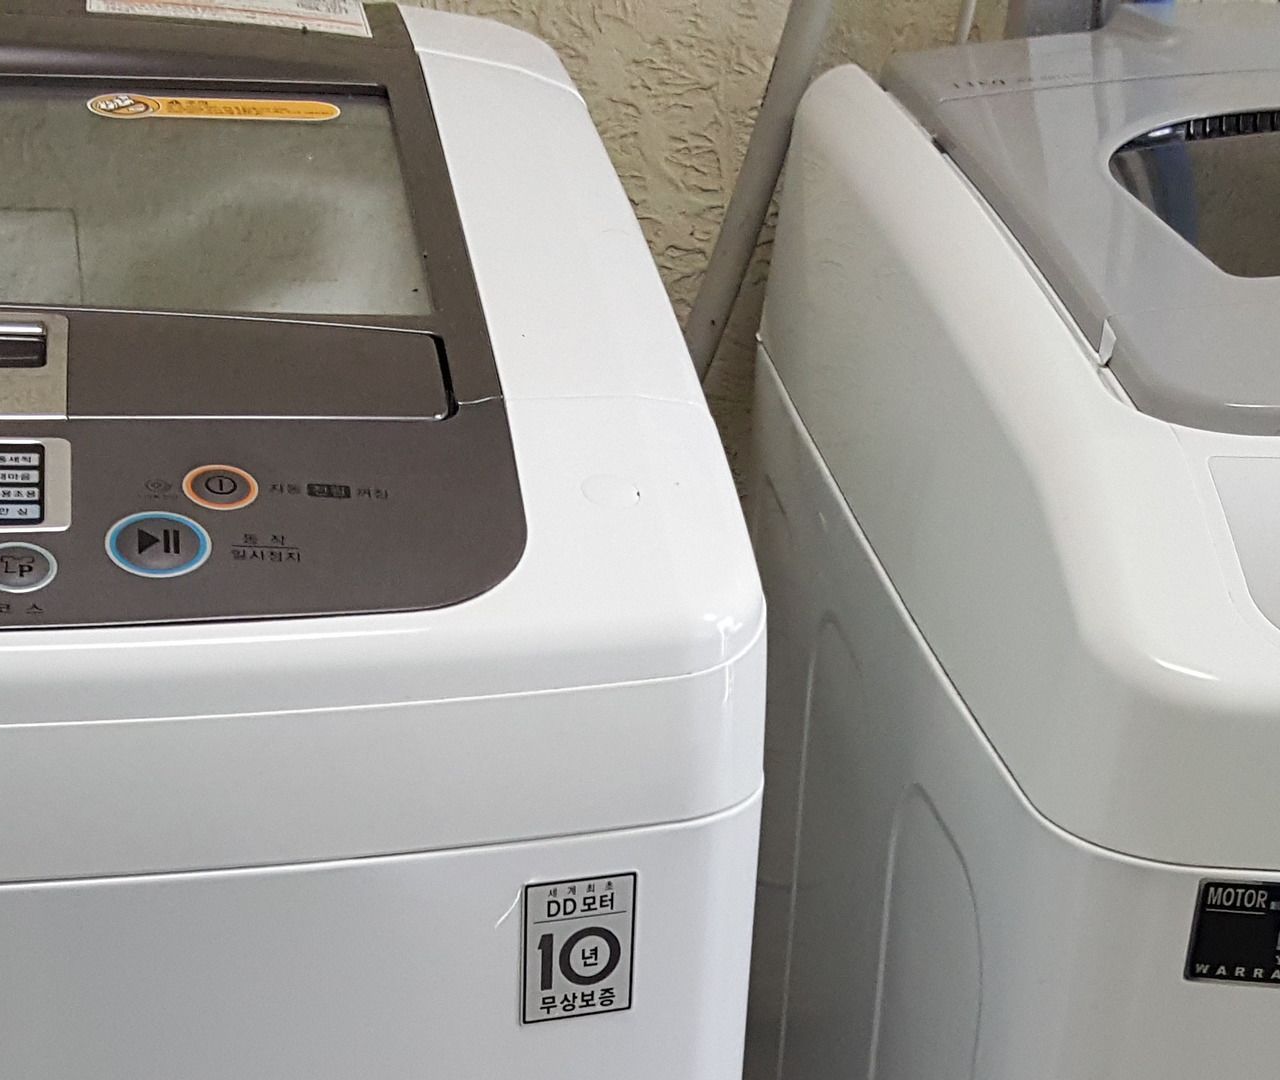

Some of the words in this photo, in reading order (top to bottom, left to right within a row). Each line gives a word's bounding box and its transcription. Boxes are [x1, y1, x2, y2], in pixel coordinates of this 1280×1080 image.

[231, 549, 301, 563] 일시정지
[1207, 886, 1268, 909] MOTOR
[581, 946, 599, 968] 년
[539, 987, 616, 1015] 무상보증
